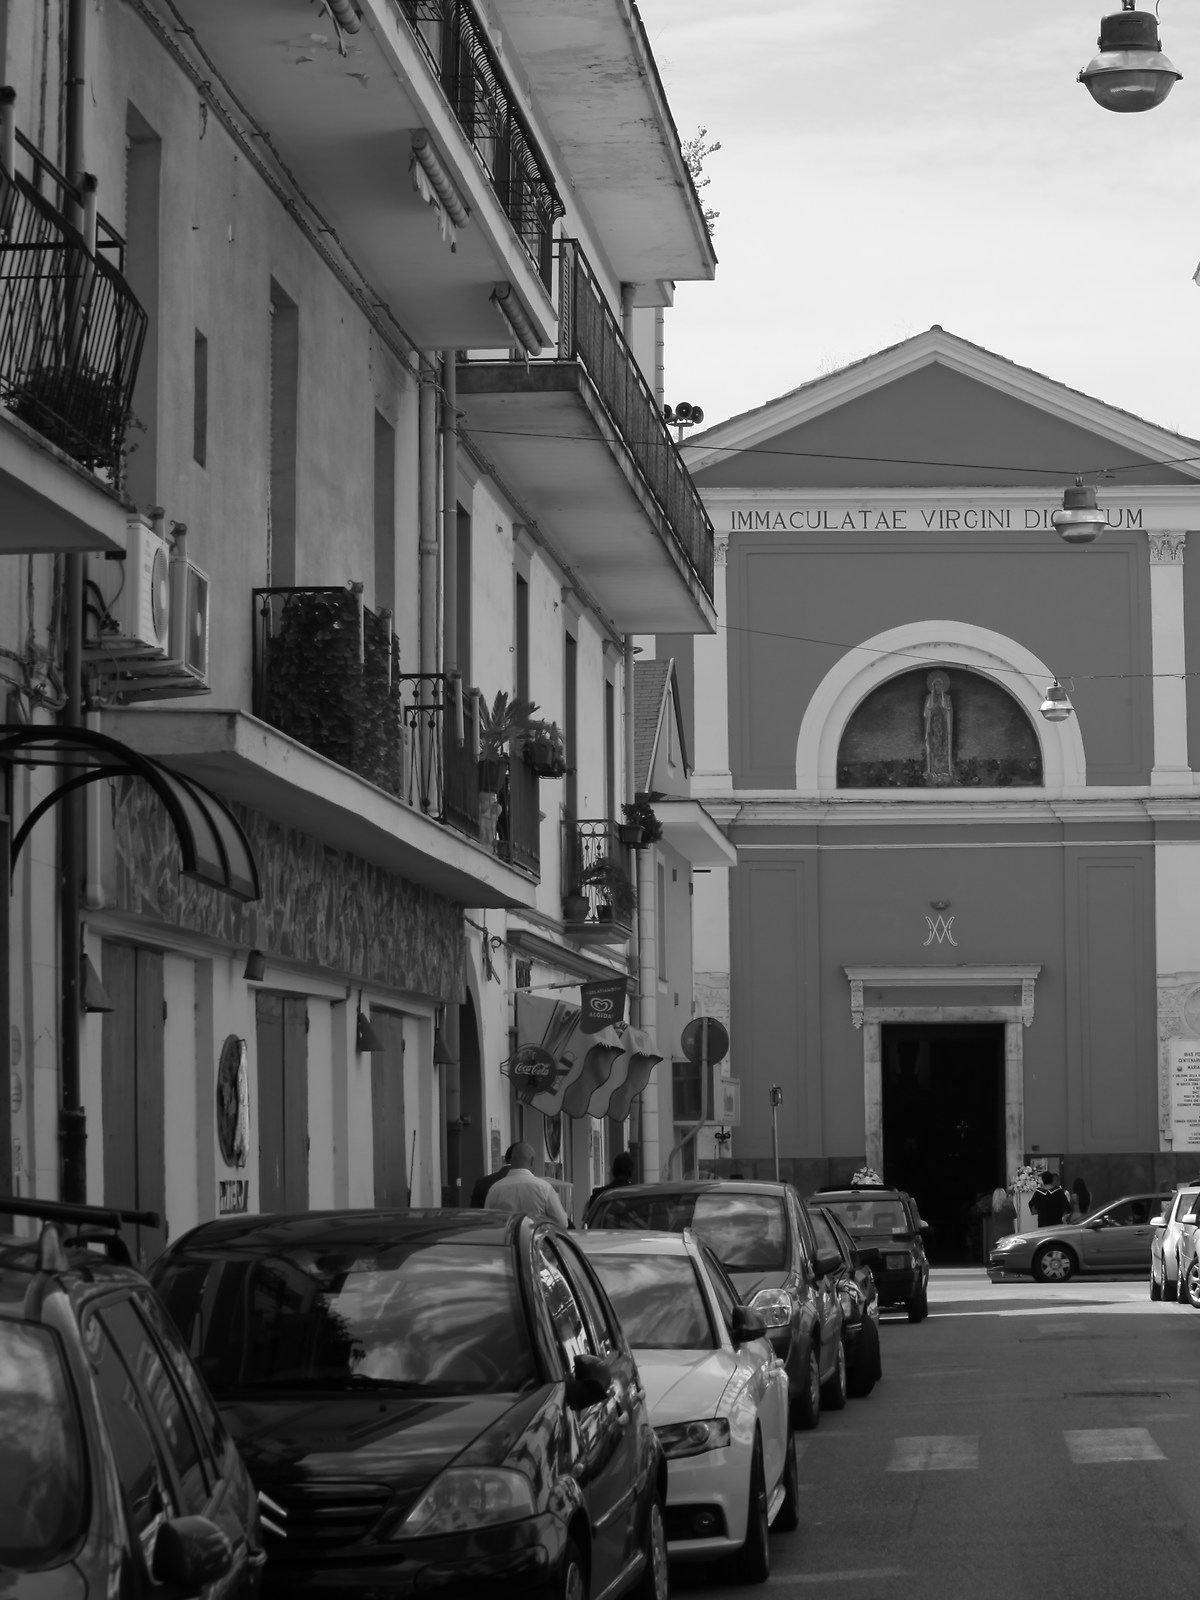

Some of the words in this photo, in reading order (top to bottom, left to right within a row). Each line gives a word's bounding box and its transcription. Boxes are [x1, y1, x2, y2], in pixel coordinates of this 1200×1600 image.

[731, 509, 907, 530] IMMACULATAE
[920, 508, 1012, 529] VIRGINI
[1024, 508, 1143, 529] DICUM
[589, 1011, 612, 1019] ALGIDA
